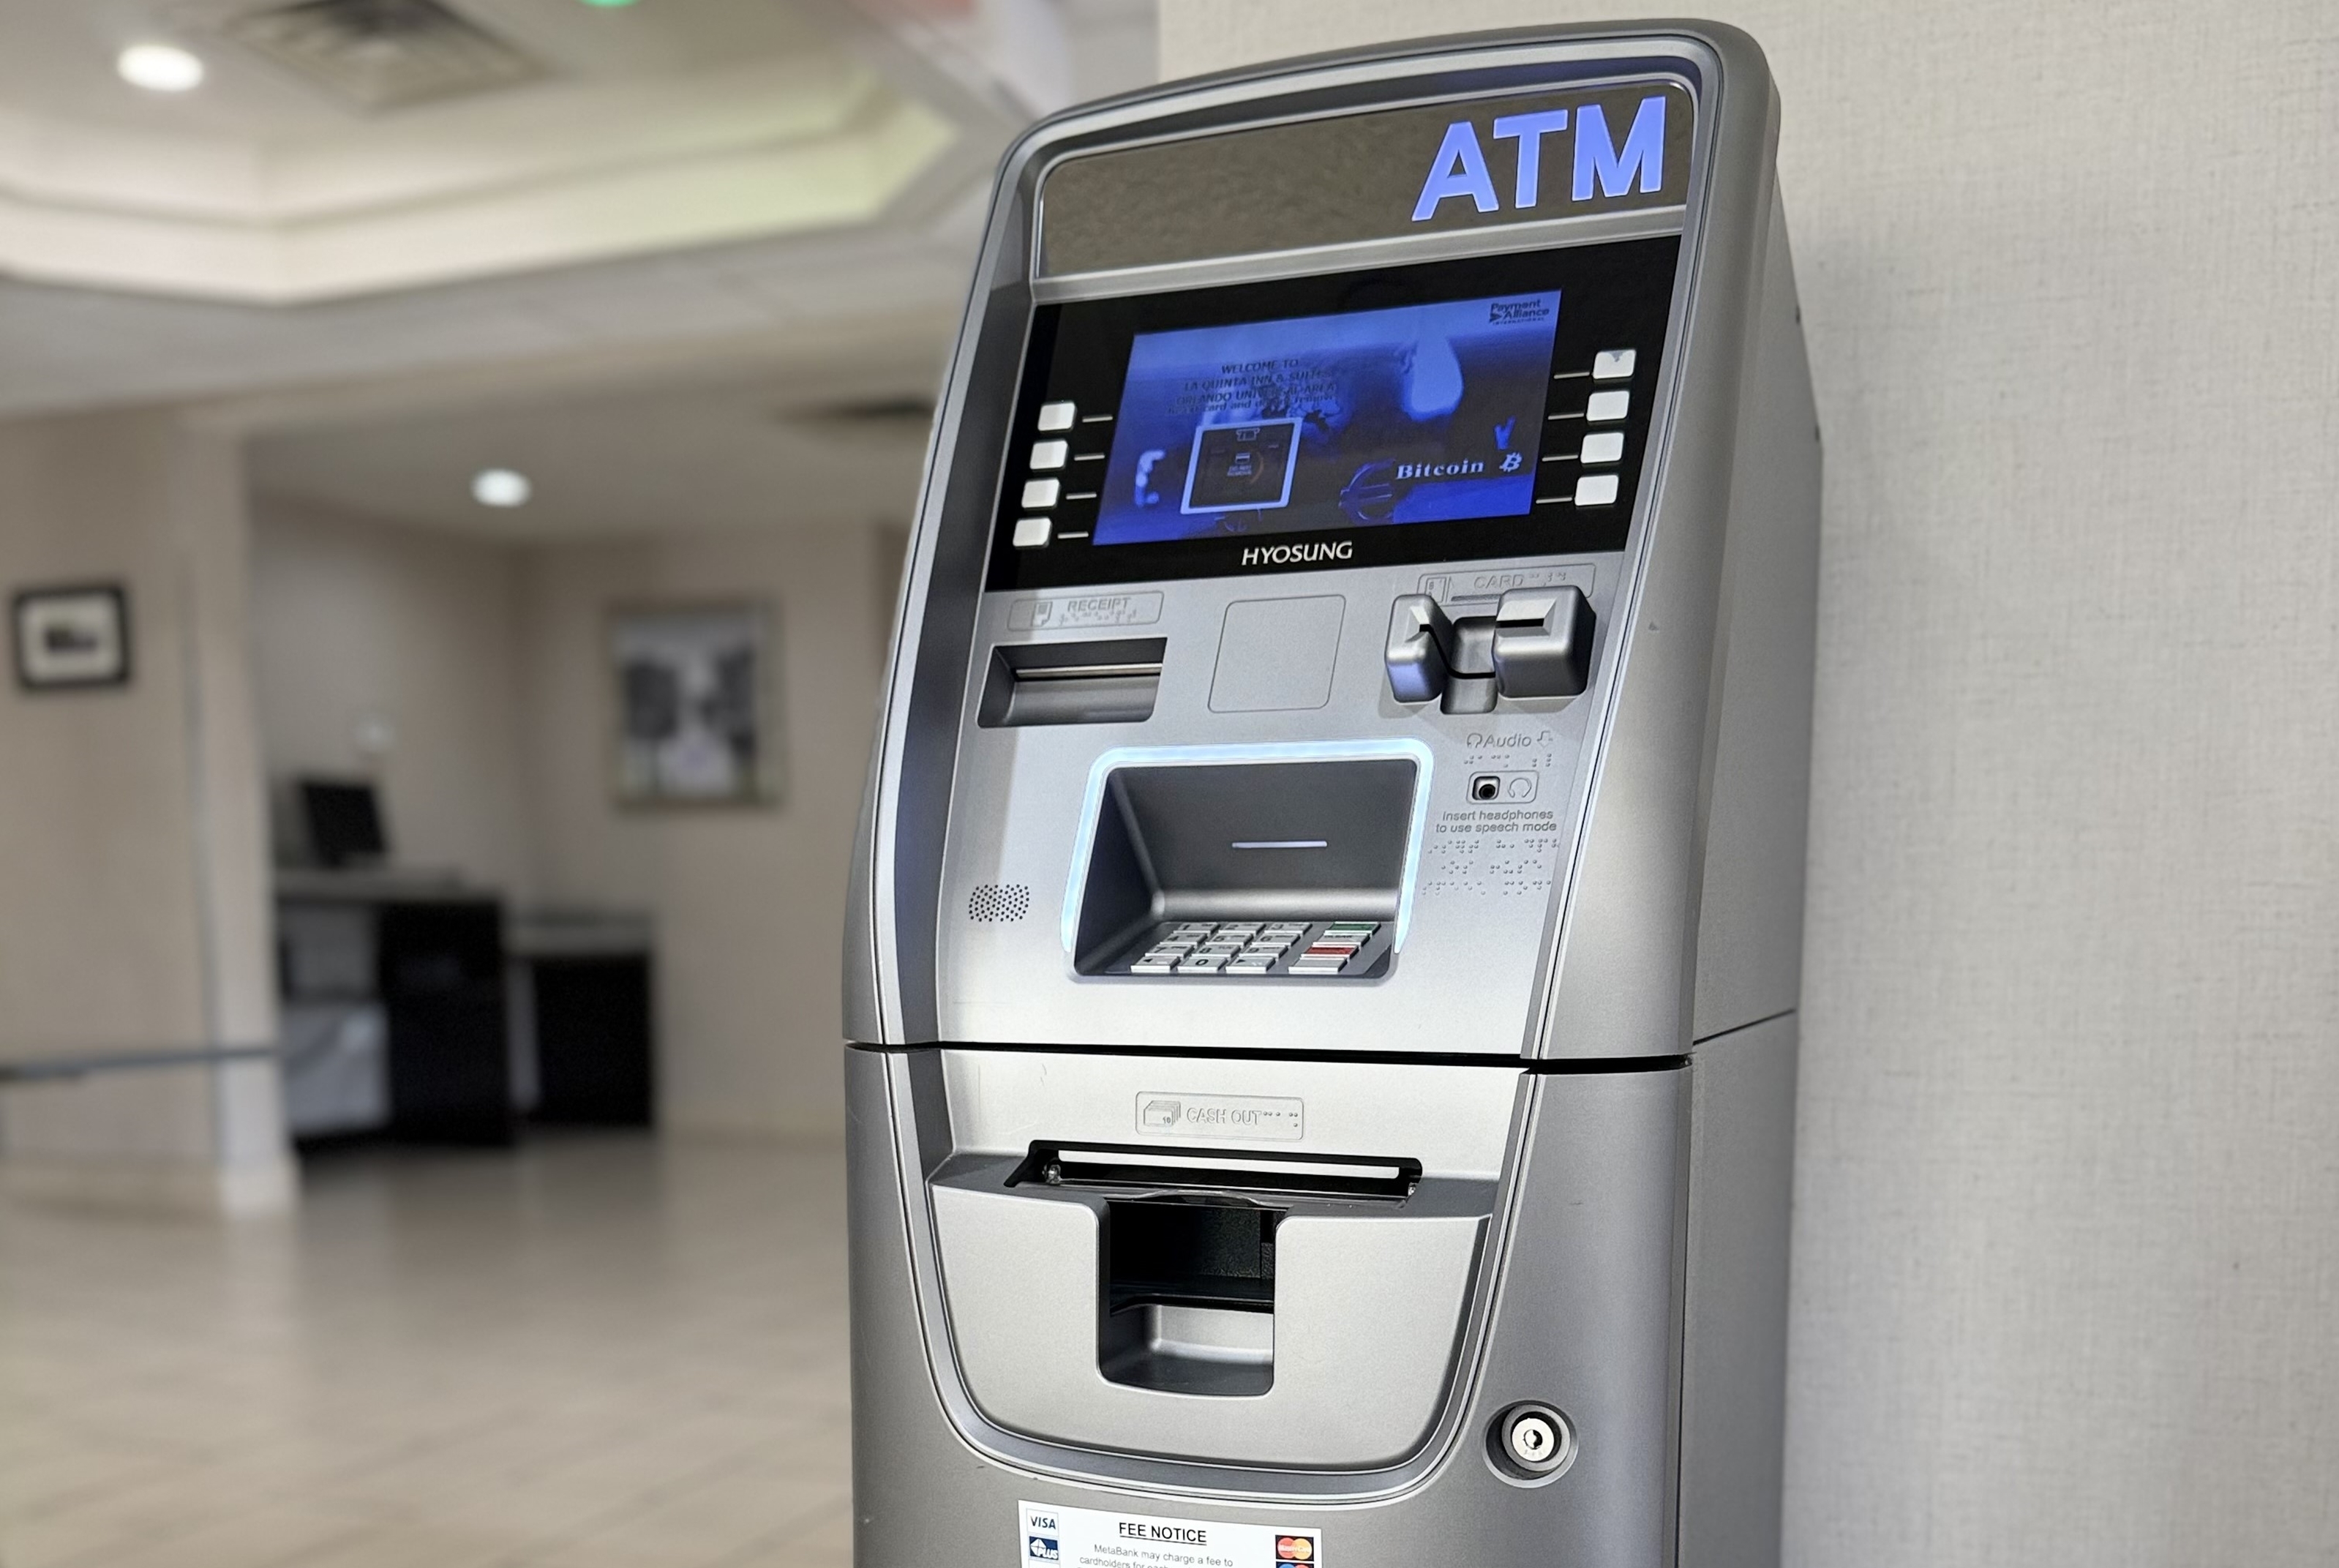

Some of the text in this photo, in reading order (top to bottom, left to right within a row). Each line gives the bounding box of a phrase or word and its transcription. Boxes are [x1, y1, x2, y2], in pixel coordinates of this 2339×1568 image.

[1412, 96, 1667, 221] ATM
[1490, 299, 1542, 313] Payment
[1503, 308, 1550, 320] Alliance
[1221, 359, 1299, 374] WELCOME TO
[1184, 381, 1198, 392] LA
[1201, 376, 1247, 391] QUINTA
[1251, 374, 1273, 386] INN
[1275, 372, 1284, 383] &
[1176, 392, 1232, 405] ORLANDO
[1395, 458, 1484, 479] Bitcoin
[1241, 540, 1353, 566] HYOSUNG
[1473, 574, 1525, 589] CARD
[1067, 597, 1131, 612] RECEIPT
[1483, 733, 1532, 749] Audio
[1442, 809, 1554, 822] Insert headphones
[1435, 821, 1558, 834] to use speech mode
[1186, 1107, 1263, 1126] CASH OUT
[1029, 1515, 1056, 1530] VISA
[1119, 1522, 1207, 1543] FEE NOTICE
[1037, 1547, 1059, 1560] PLUS
[1094, 1544, 1139, 1558] MetaBank
[1141, 1550, 1160, 1562] may
[1163, 1552, 1195, 1565] charge
[1206, 1556, 1222, 1566] fee
[1224, 1558, 1234, 1567] to
[1078, 1556, 1131, 1568] cardholders
